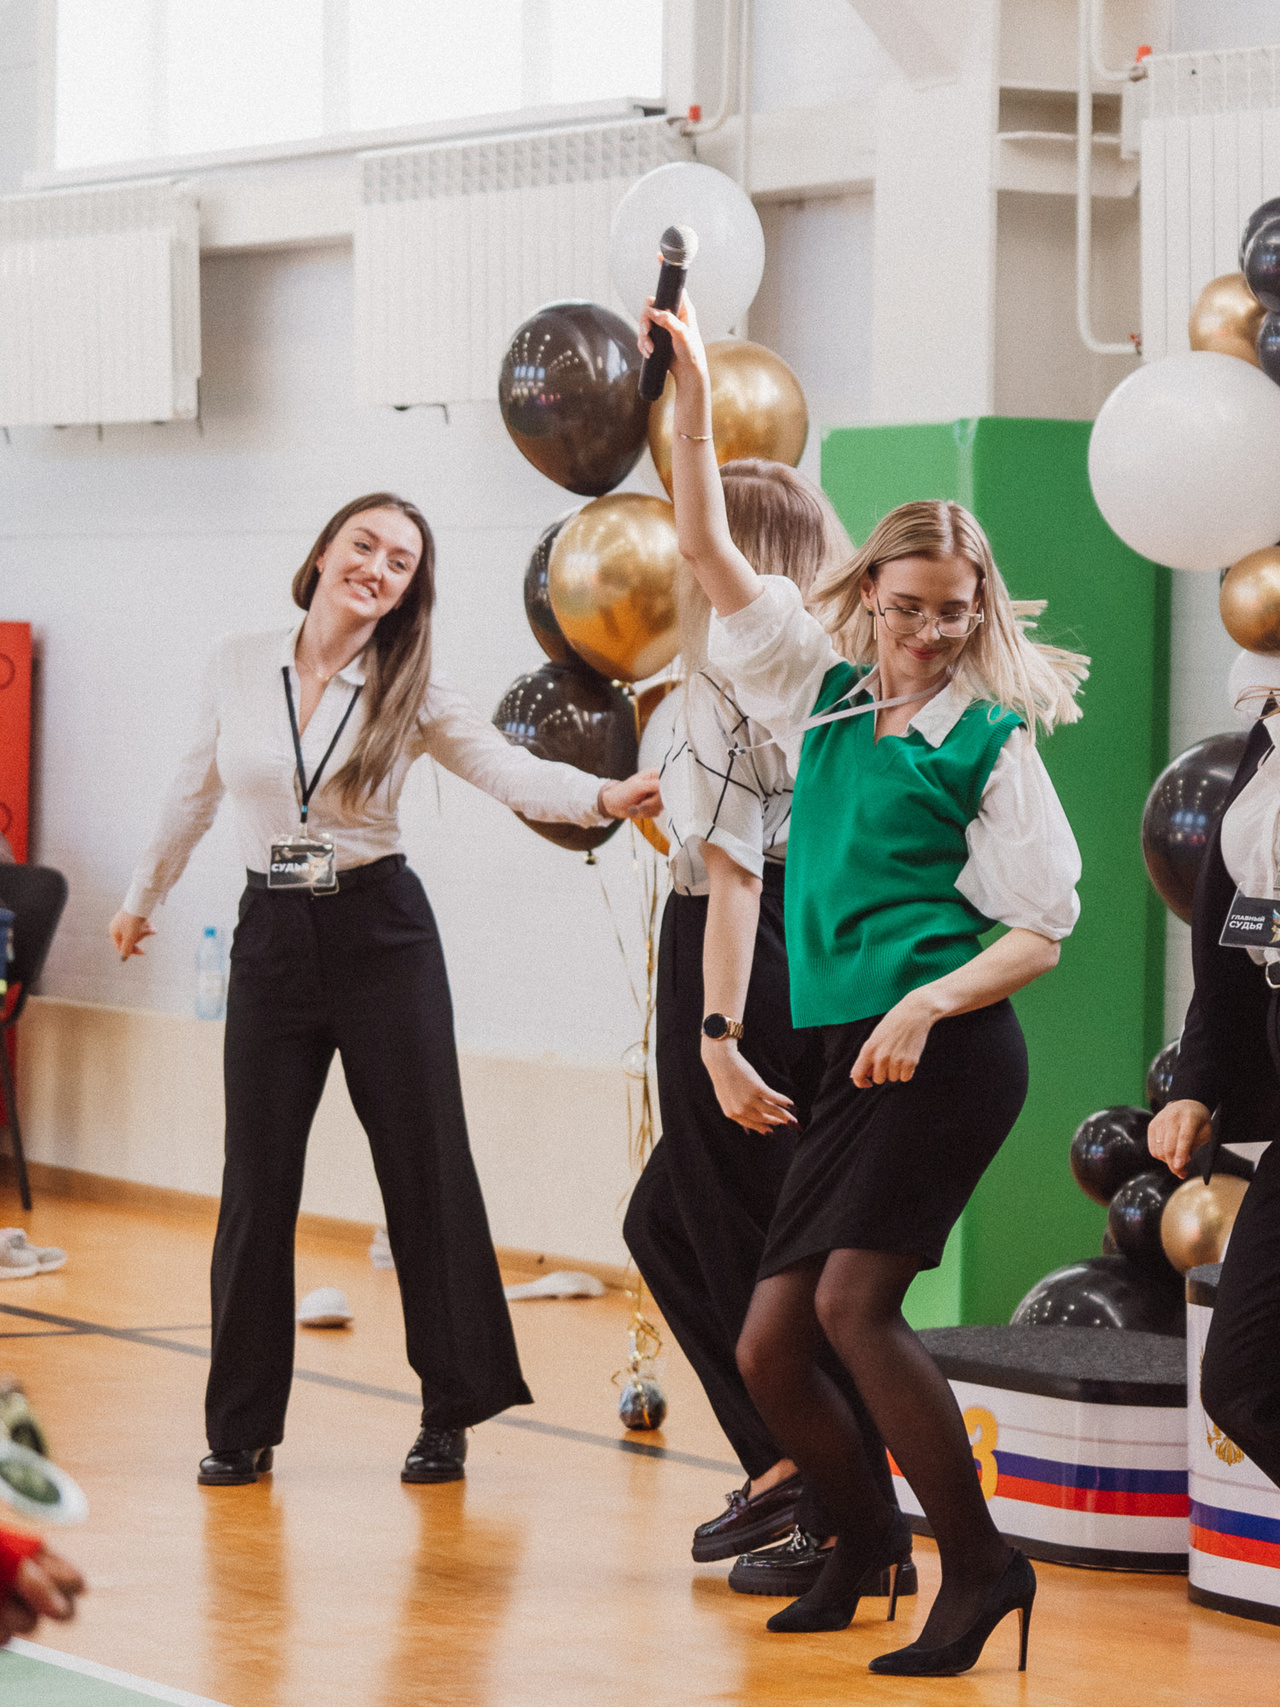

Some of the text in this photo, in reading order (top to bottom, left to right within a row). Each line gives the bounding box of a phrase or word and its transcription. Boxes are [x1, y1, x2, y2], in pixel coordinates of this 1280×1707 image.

[1230, 914, 1265, 922] ГЛАВНЫЙ
[1229, 920, 1263, 930] СУДЬЯ
[962, 1406, 999, 1501] 3
